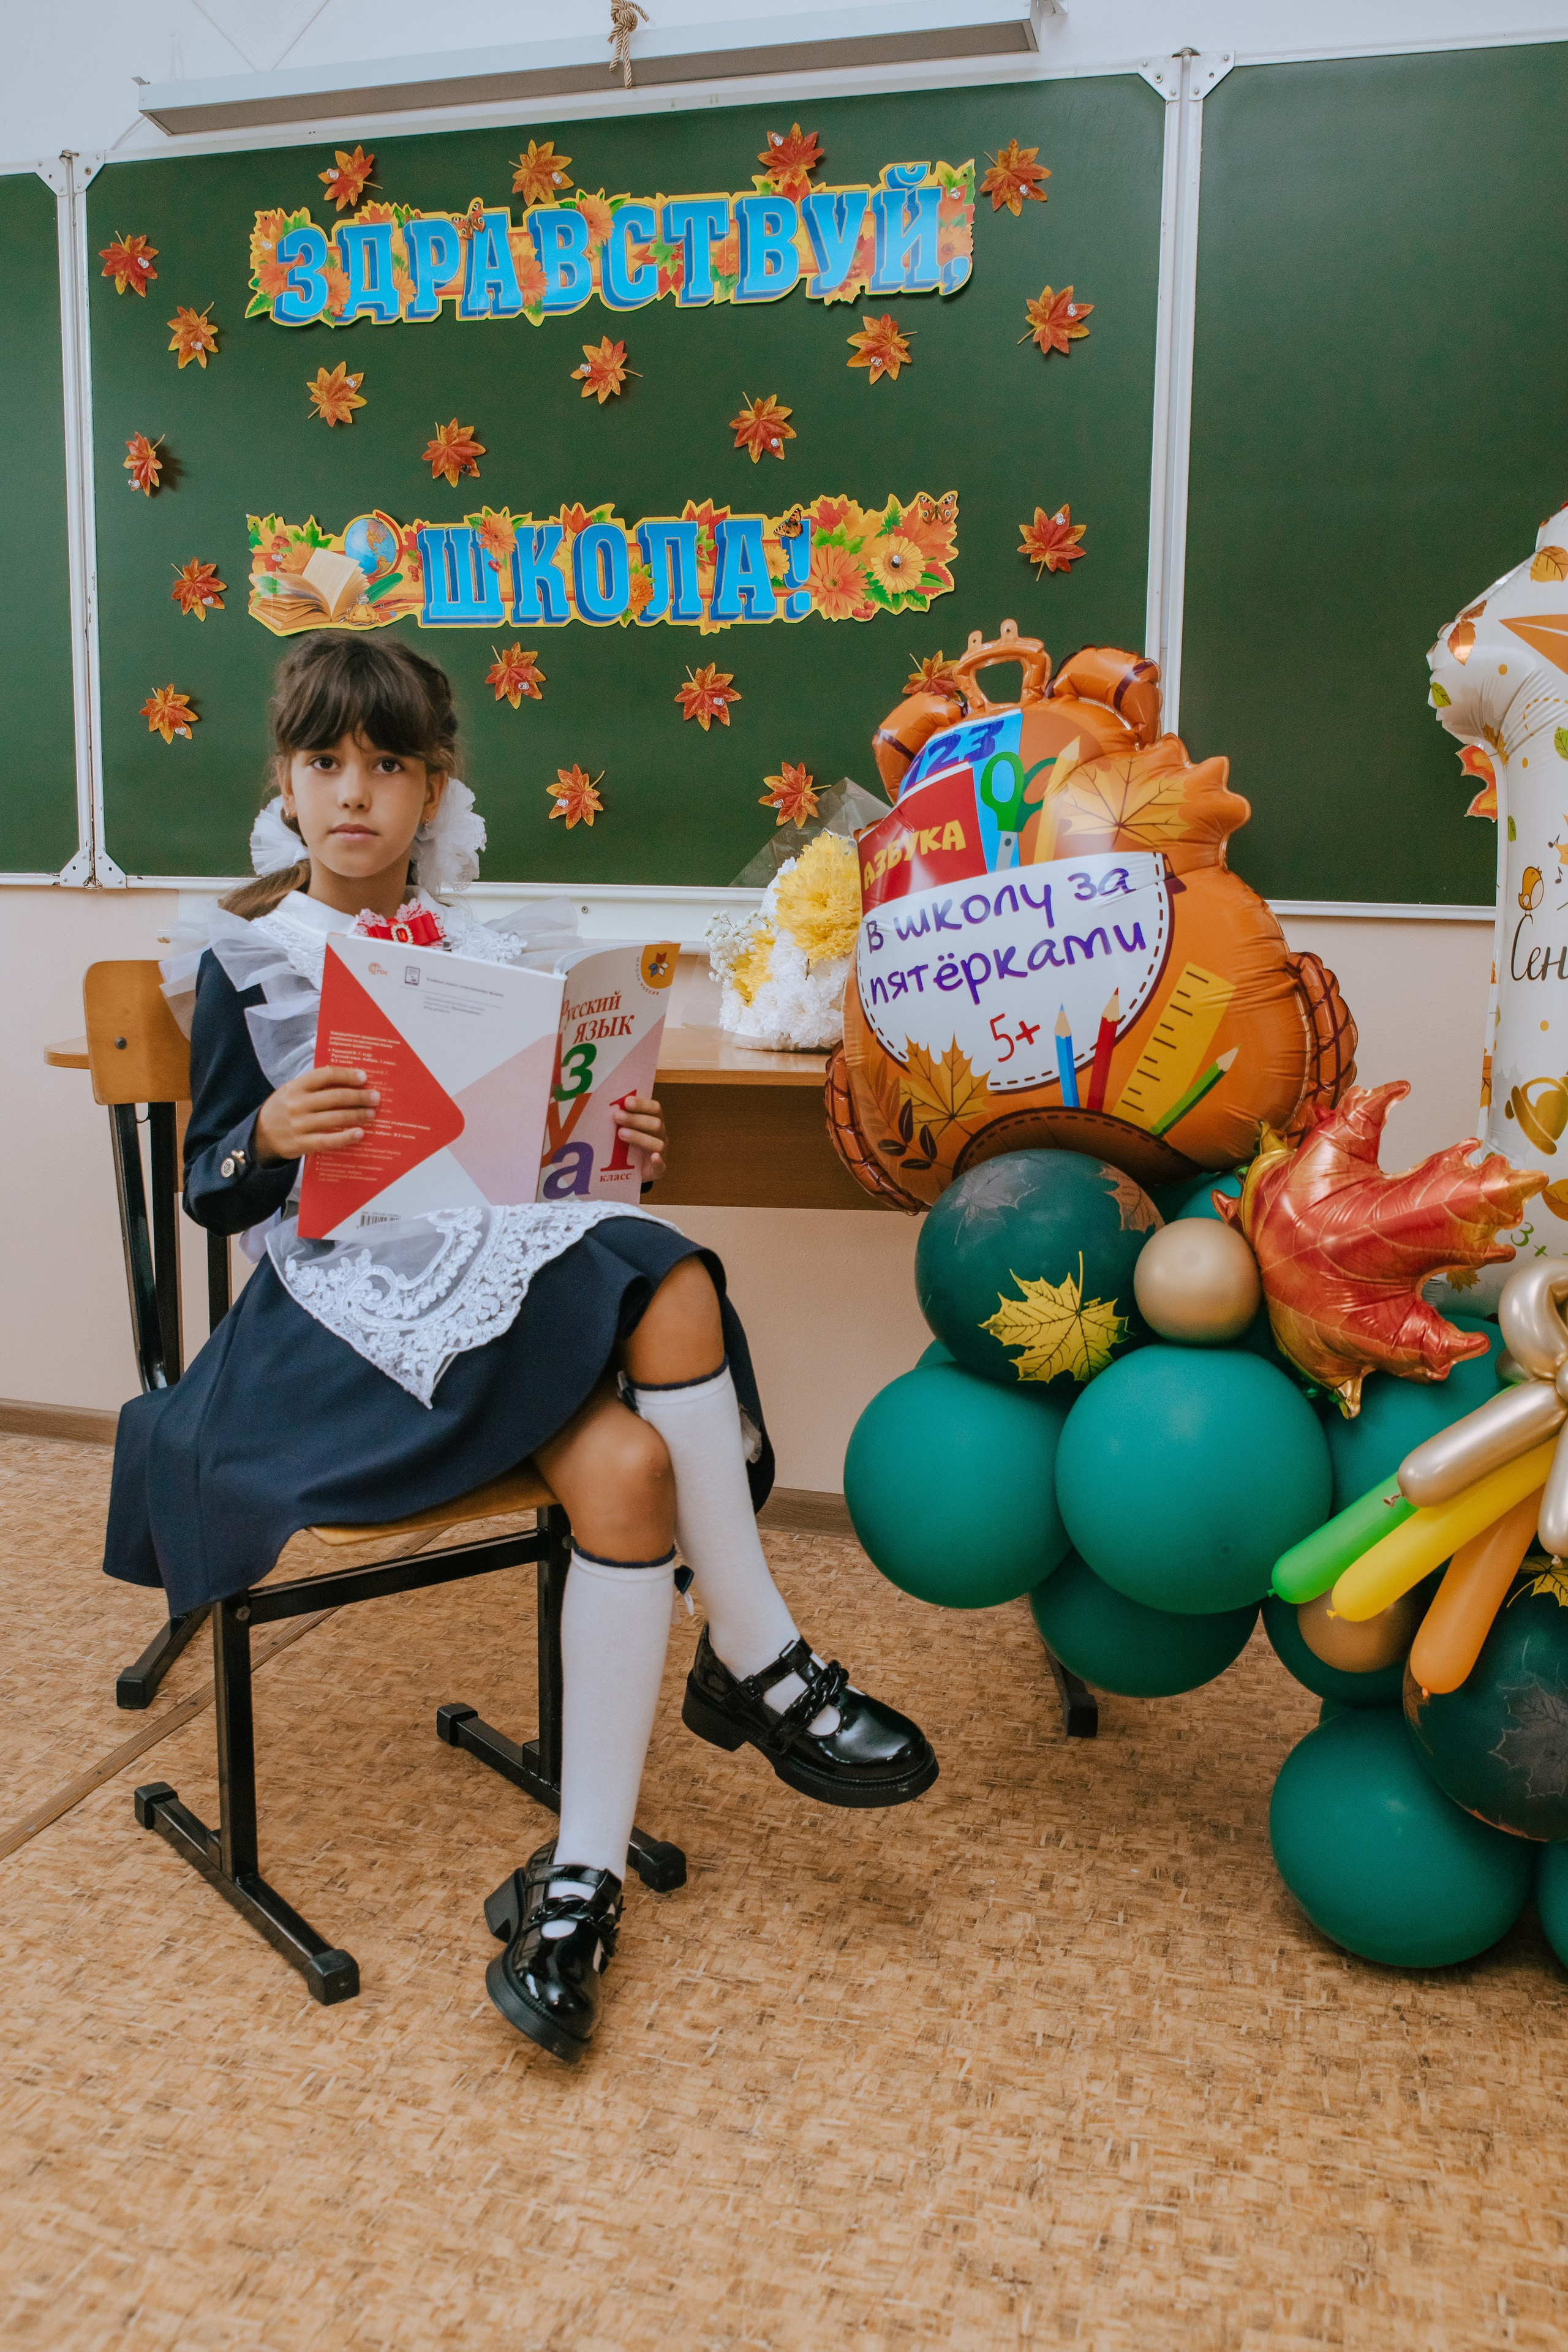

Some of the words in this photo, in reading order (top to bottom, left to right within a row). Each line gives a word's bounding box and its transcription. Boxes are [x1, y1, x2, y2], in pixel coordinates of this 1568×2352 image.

[274, 162, 973, 325] ЗДРАВСТВУЙ,
[417, 518, 813, 626] ШКОЛА!
[903, 720, 1005, 791] 123
[864, 820, 967, 891] АЗБУКА
[893, 881, 1055, 929] школу
[1068, 867, 1137, 902] за
[870, 921, 1147, 1006] пятёрками
[560, 989, 623, 1031] Русский
[989, 1012, 1041, 1063] 5+
[600, 1089, 638, 1172] 1
[600, 1172, 632, 1183] класс
